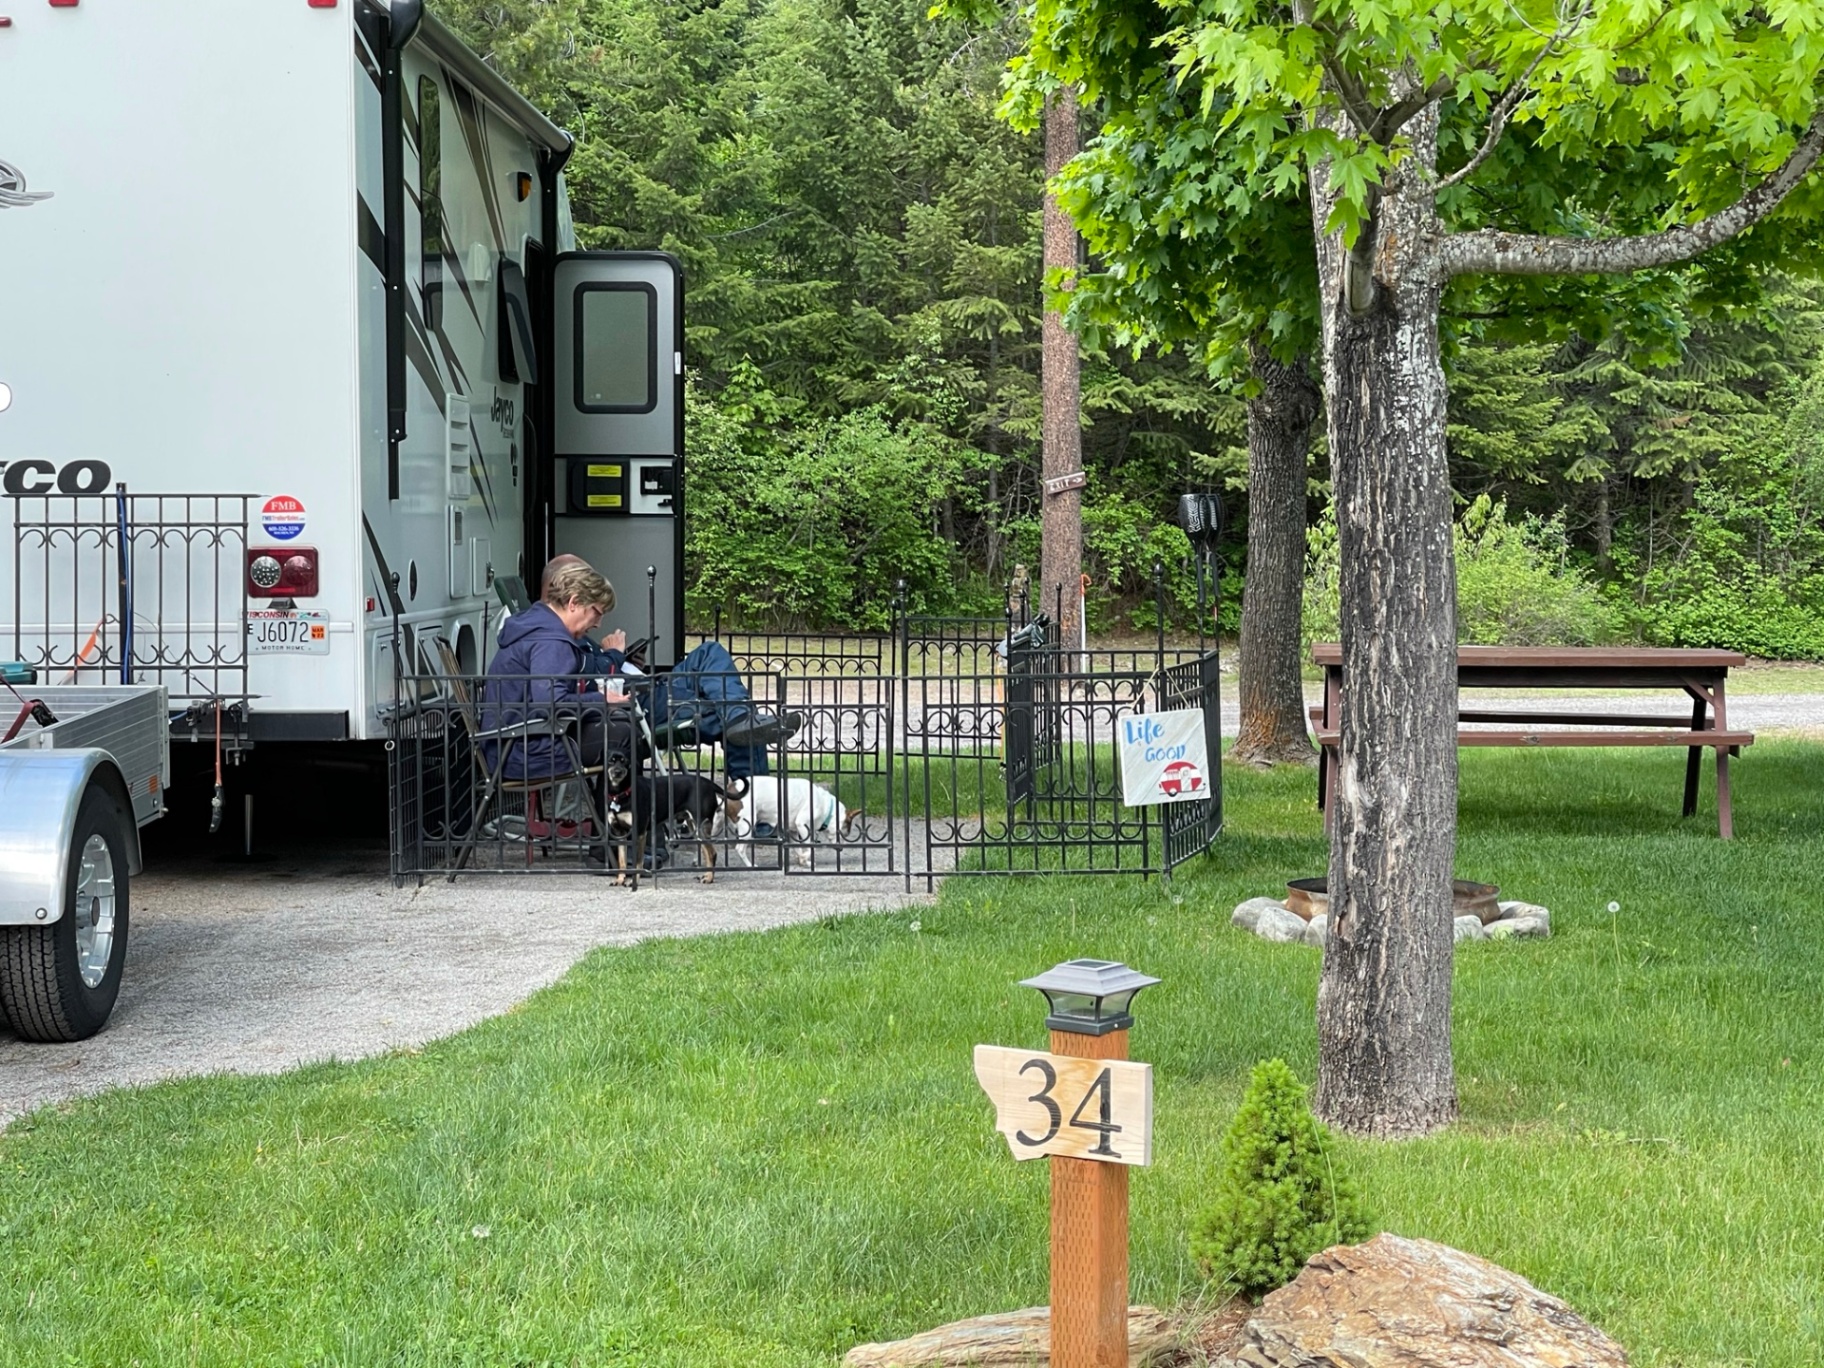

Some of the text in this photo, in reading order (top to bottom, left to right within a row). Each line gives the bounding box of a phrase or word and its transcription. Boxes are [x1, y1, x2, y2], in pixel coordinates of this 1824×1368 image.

[491, 385, 514, 432] Jayco
[0, 459, 111, 494] CO
[1050, 478, 1069, 491] EXIT
[271, 501, 296, 511] FMB
[242, 611, 289, 619] ISCONSIN
[257, 621, 309, 643] J6072
[1126, 718, 1165, 745] Life
[1145, 744, 1186, 763] GOOD
[1016, 1058, 1122, 1159] 34
